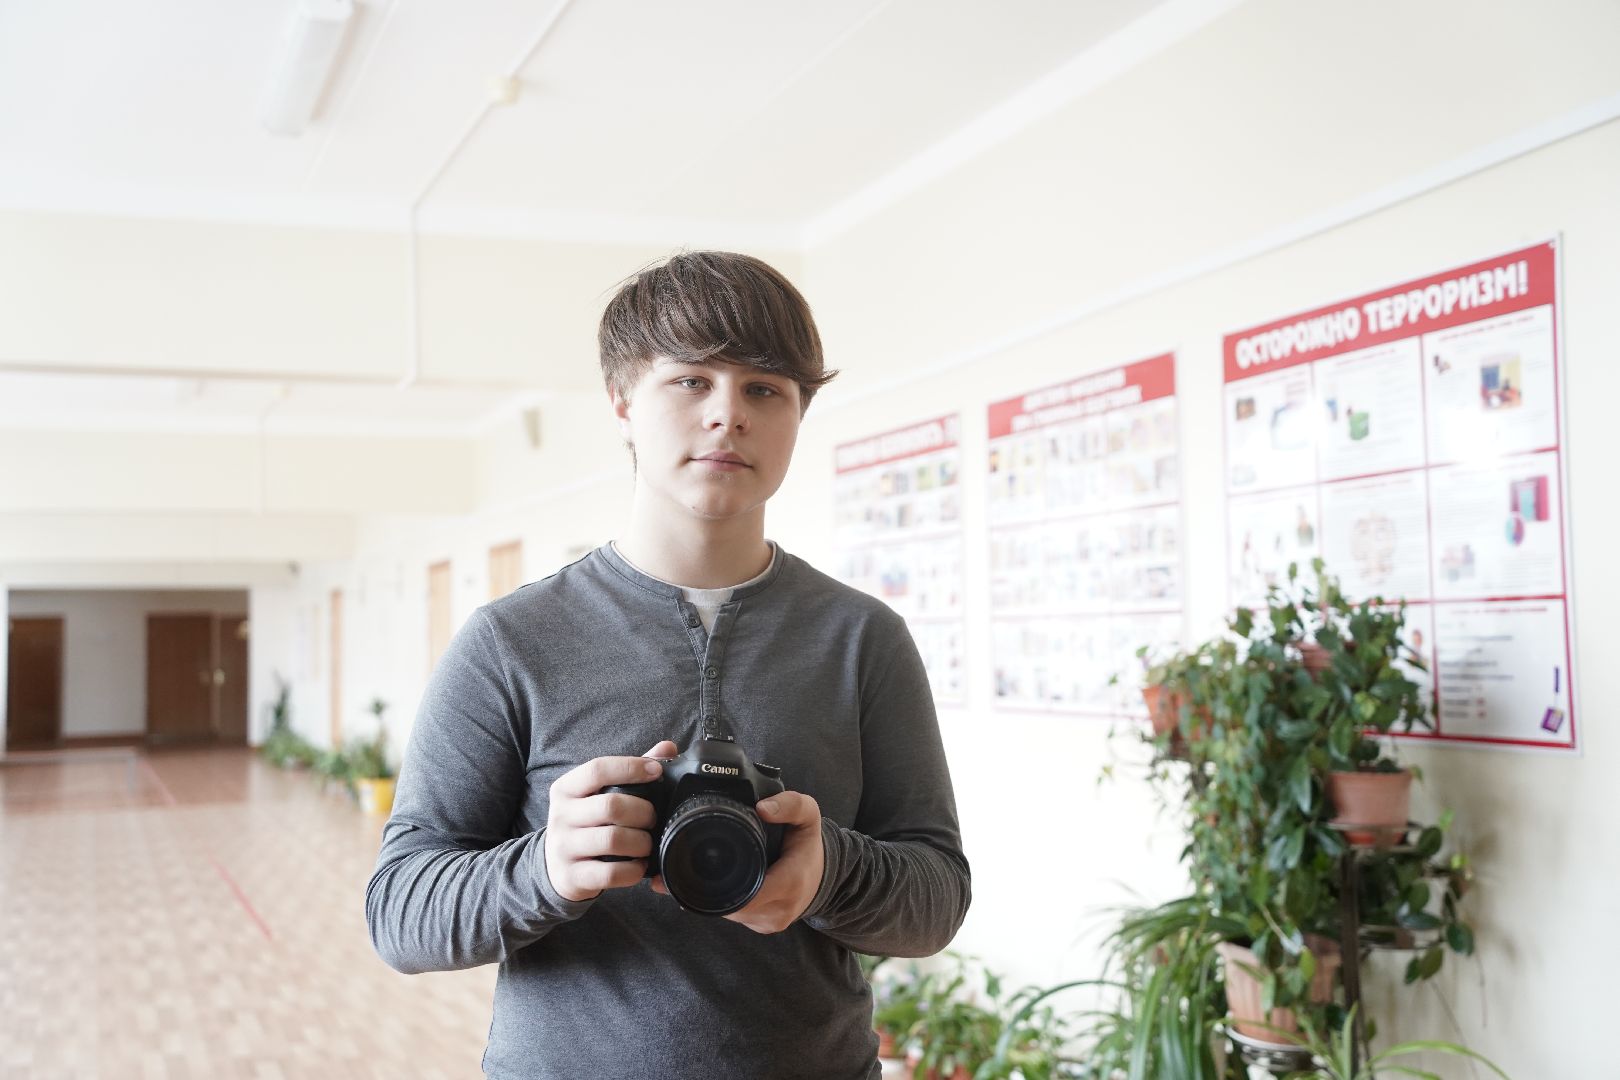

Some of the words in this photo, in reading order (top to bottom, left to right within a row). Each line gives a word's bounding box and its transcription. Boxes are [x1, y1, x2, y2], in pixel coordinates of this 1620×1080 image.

[1235, 307, 1361, 369] ОСТОРОЖНО
[1363, 260, 1528, 334] ТЕРРОРИЗМ!
[701, 763, 739, 776] Canon
